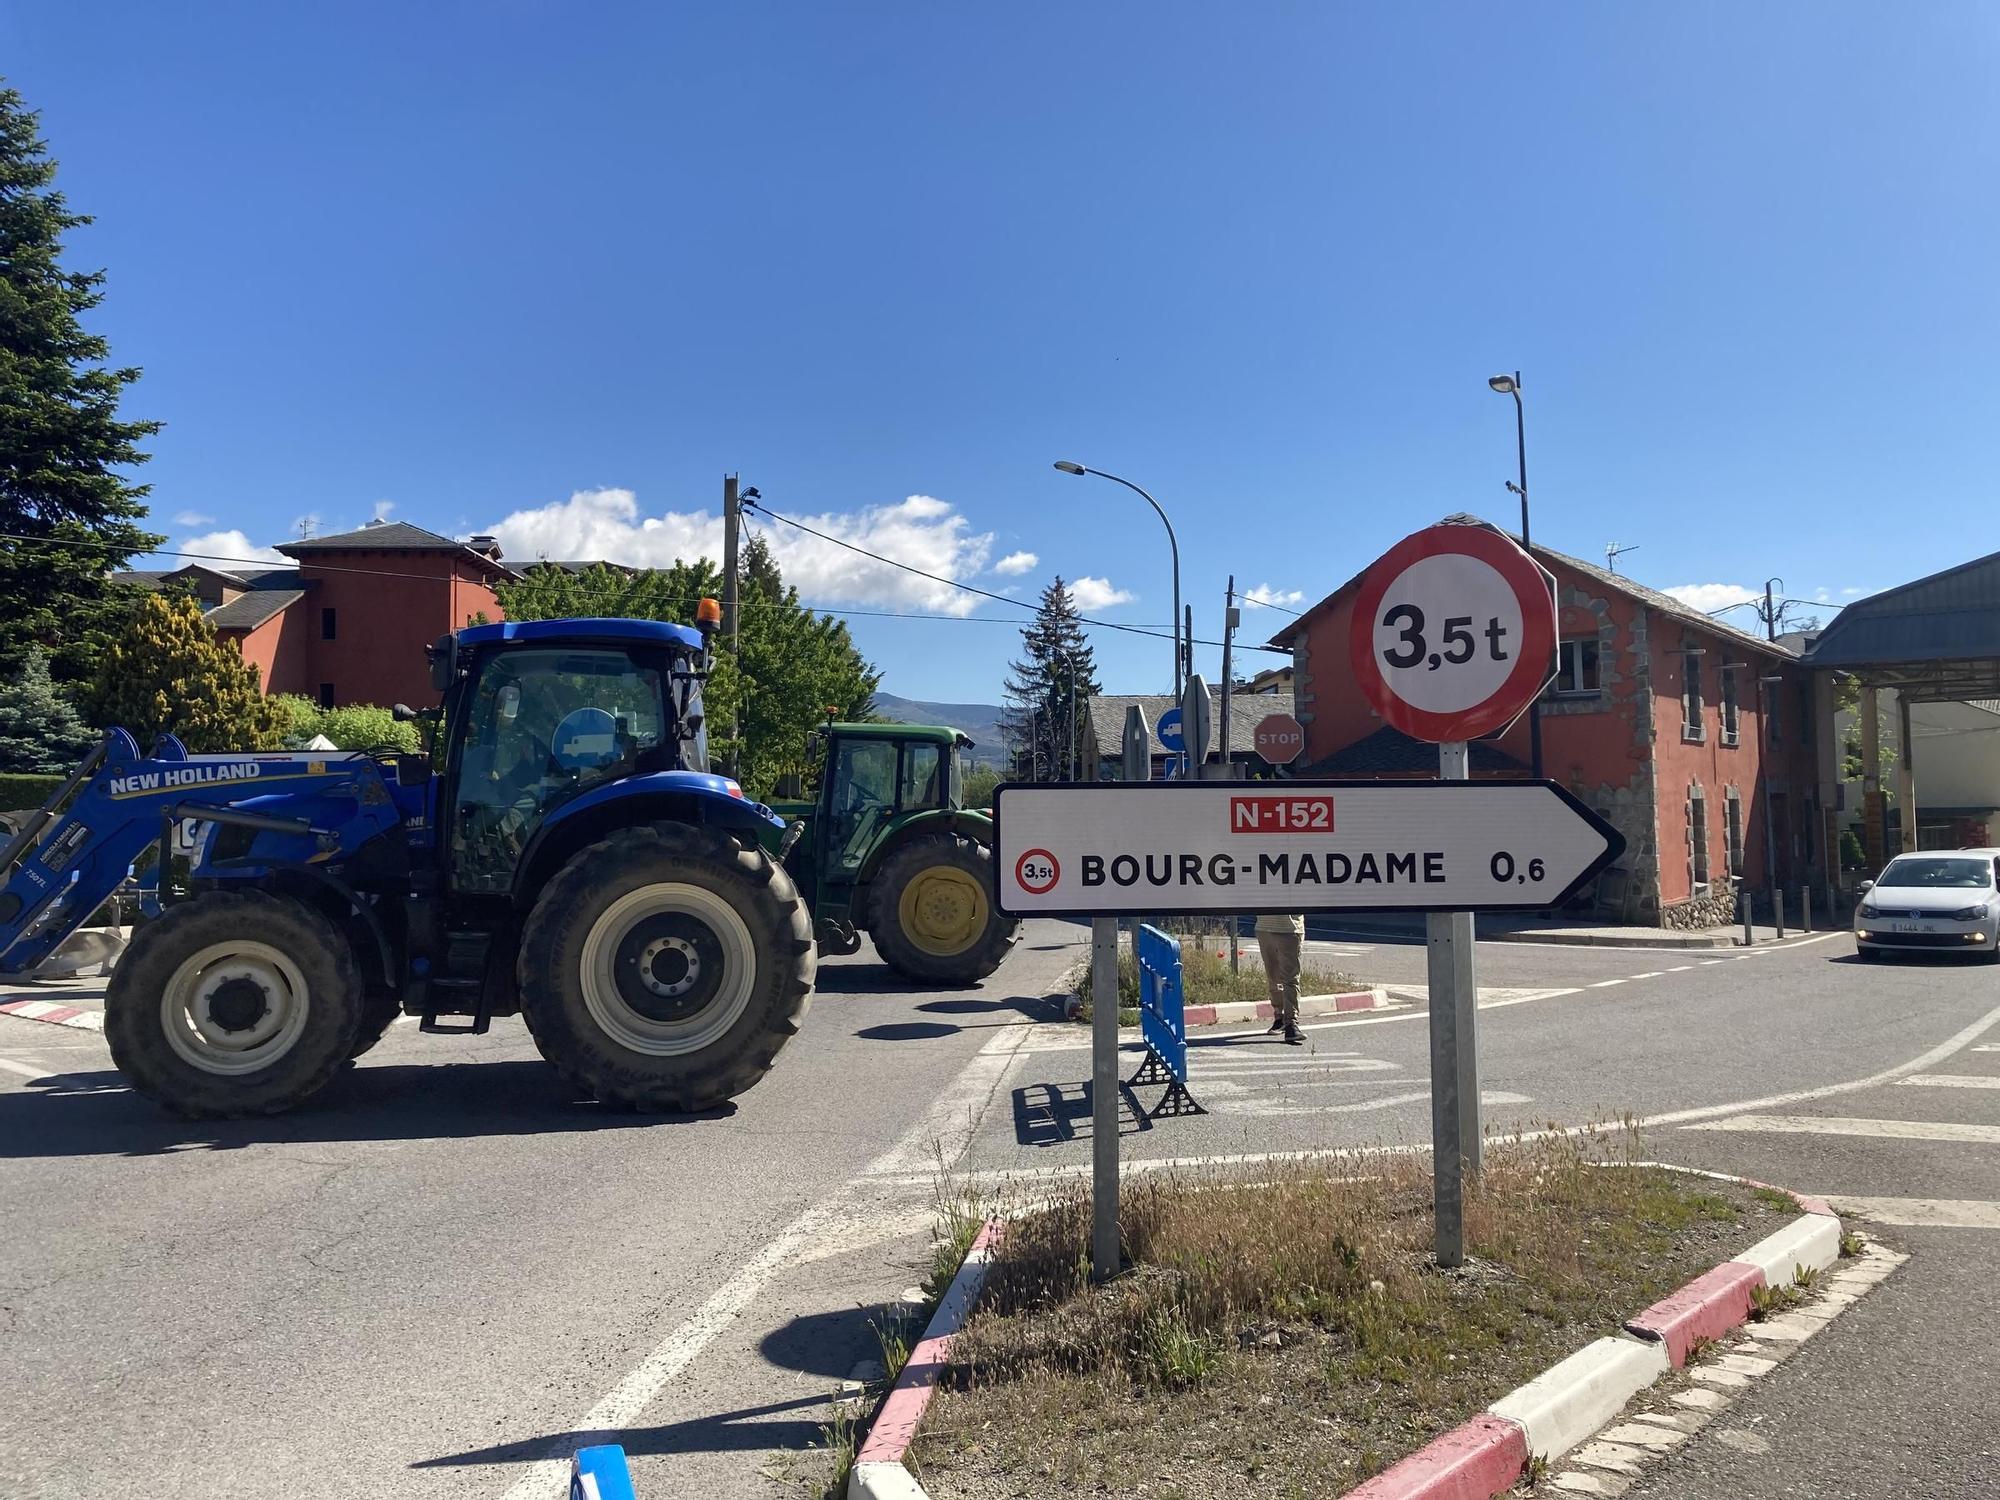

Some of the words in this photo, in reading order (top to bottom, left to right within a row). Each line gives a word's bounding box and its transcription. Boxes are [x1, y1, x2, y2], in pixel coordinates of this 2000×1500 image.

[1382, 603, 1475, 671] 3,5
[1484, 616, 1508, 661] t
[1258, 733, 1300, 744] STOP
[110, 771, 162, 795] NEW
[165, 762, 261, 786] HOLLAND
[1236, 801, 1329, 829] N-152
[1023, 863, 1053, 880] 3,5t
[1081, 852, 1447, 887] BOURG-MADAME
[1490, 851, 1546, 885] 0,6
